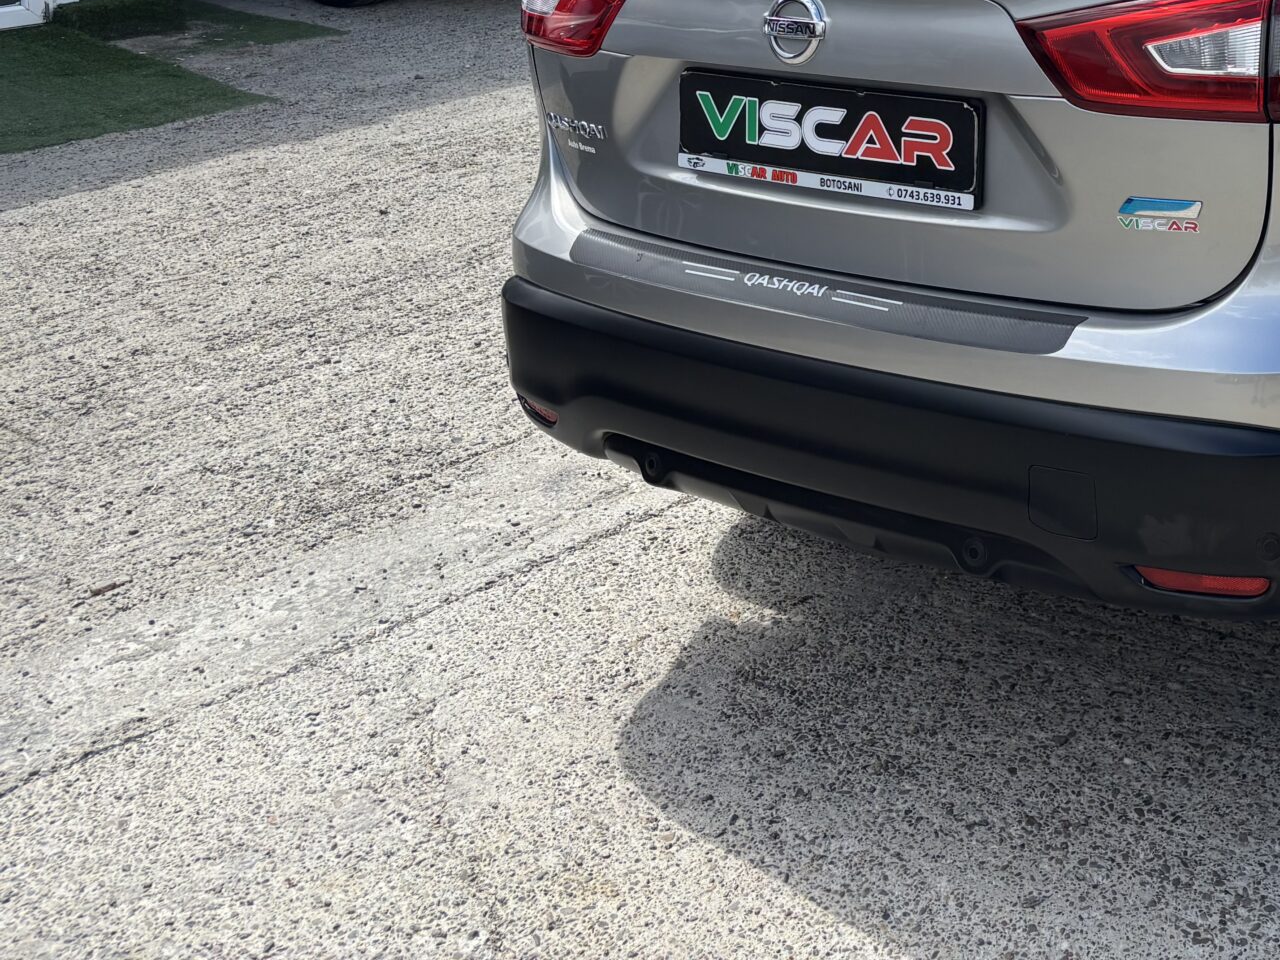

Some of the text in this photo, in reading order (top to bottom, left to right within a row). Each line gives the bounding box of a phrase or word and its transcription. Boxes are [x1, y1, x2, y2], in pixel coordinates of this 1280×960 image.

[767, 21, 816, 35] NISSAN
[696, 91, 955, 171] VISCAR
[726, 161, 962, 207] VISCAR AUTO BOTOSANI 0743.639.931
[1117, 216, 1200, 233] VISCAR
[743, 272, 828, 297] QASHQAI
